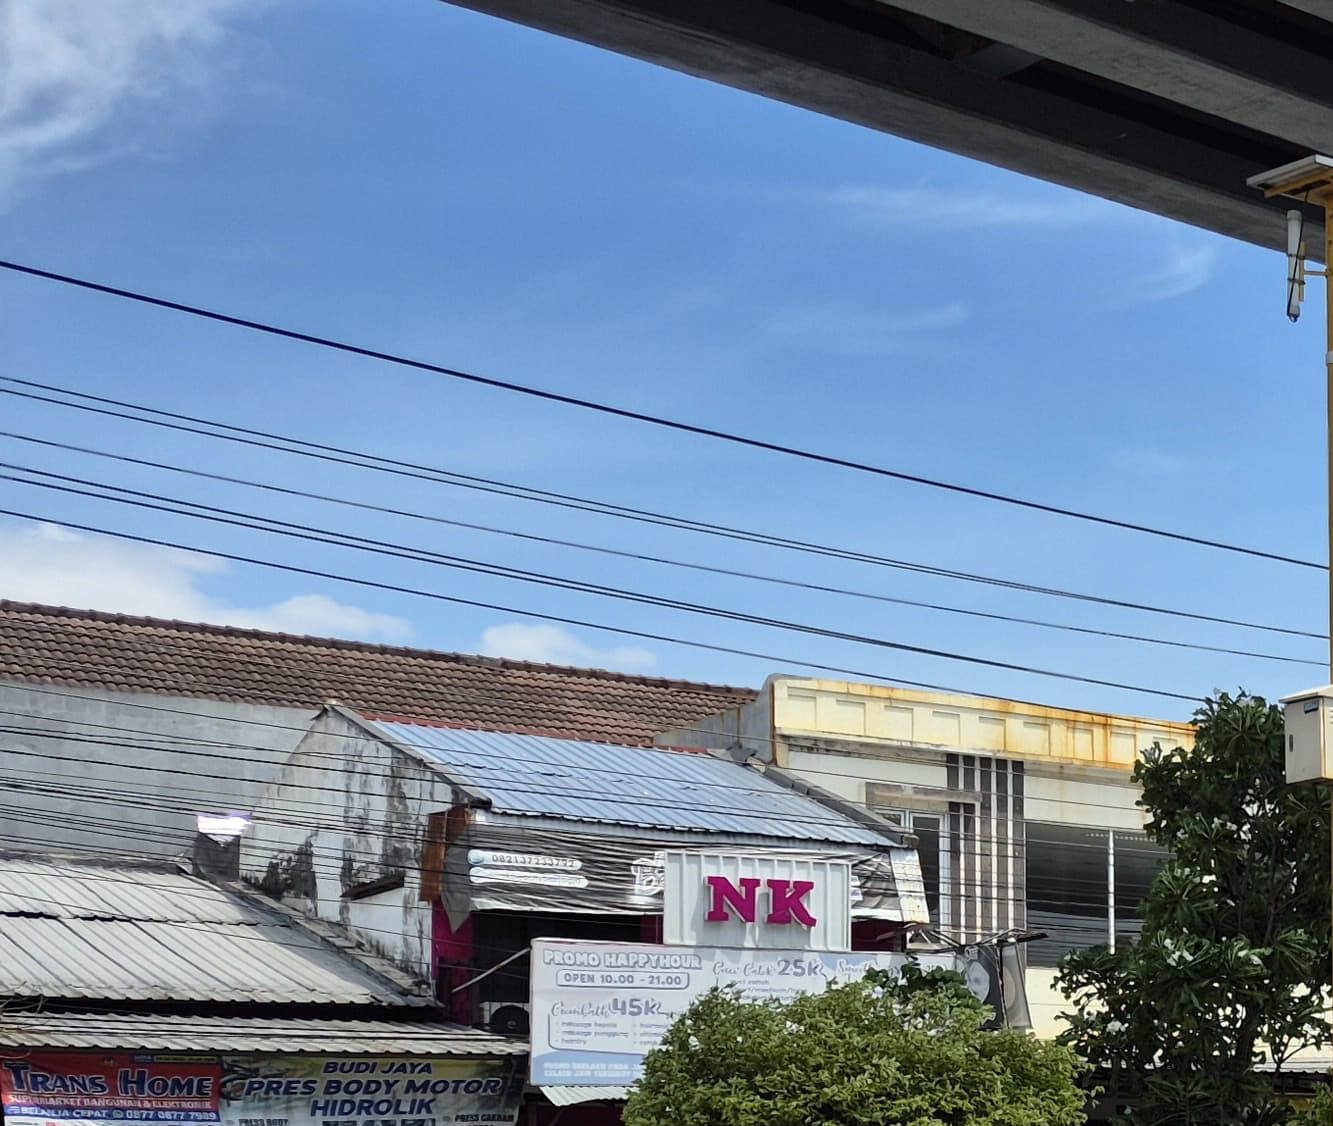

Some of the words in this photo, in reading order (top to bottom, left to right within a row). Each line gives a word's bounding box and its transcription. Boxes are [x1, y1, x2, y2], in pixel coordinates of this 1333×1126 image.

[705, 875, 818, 928] NK
[543, 950, 600, 967] PROMO
[603, 954, 702, 970] HAPPYHOUR
[564, 973, 595, 984] OPEN
[600, 974, 635, 985] 10.00
[649, 976, 682, 986] 21.00
[322, 1062, 377, 1074] BUDI
[381, 1062, 432, 1075] JAYA
[4, 1061, 109, 1095] TRANS
[117, 1067, 214, 1098] HOME
[245, 1079, 318, 1096] PRES
[322, 1079, 400, 1096] BODY
[403, 1078, 501, 1095] MOTOR
[310, 1098, 436, 1117] HIDROLIK
